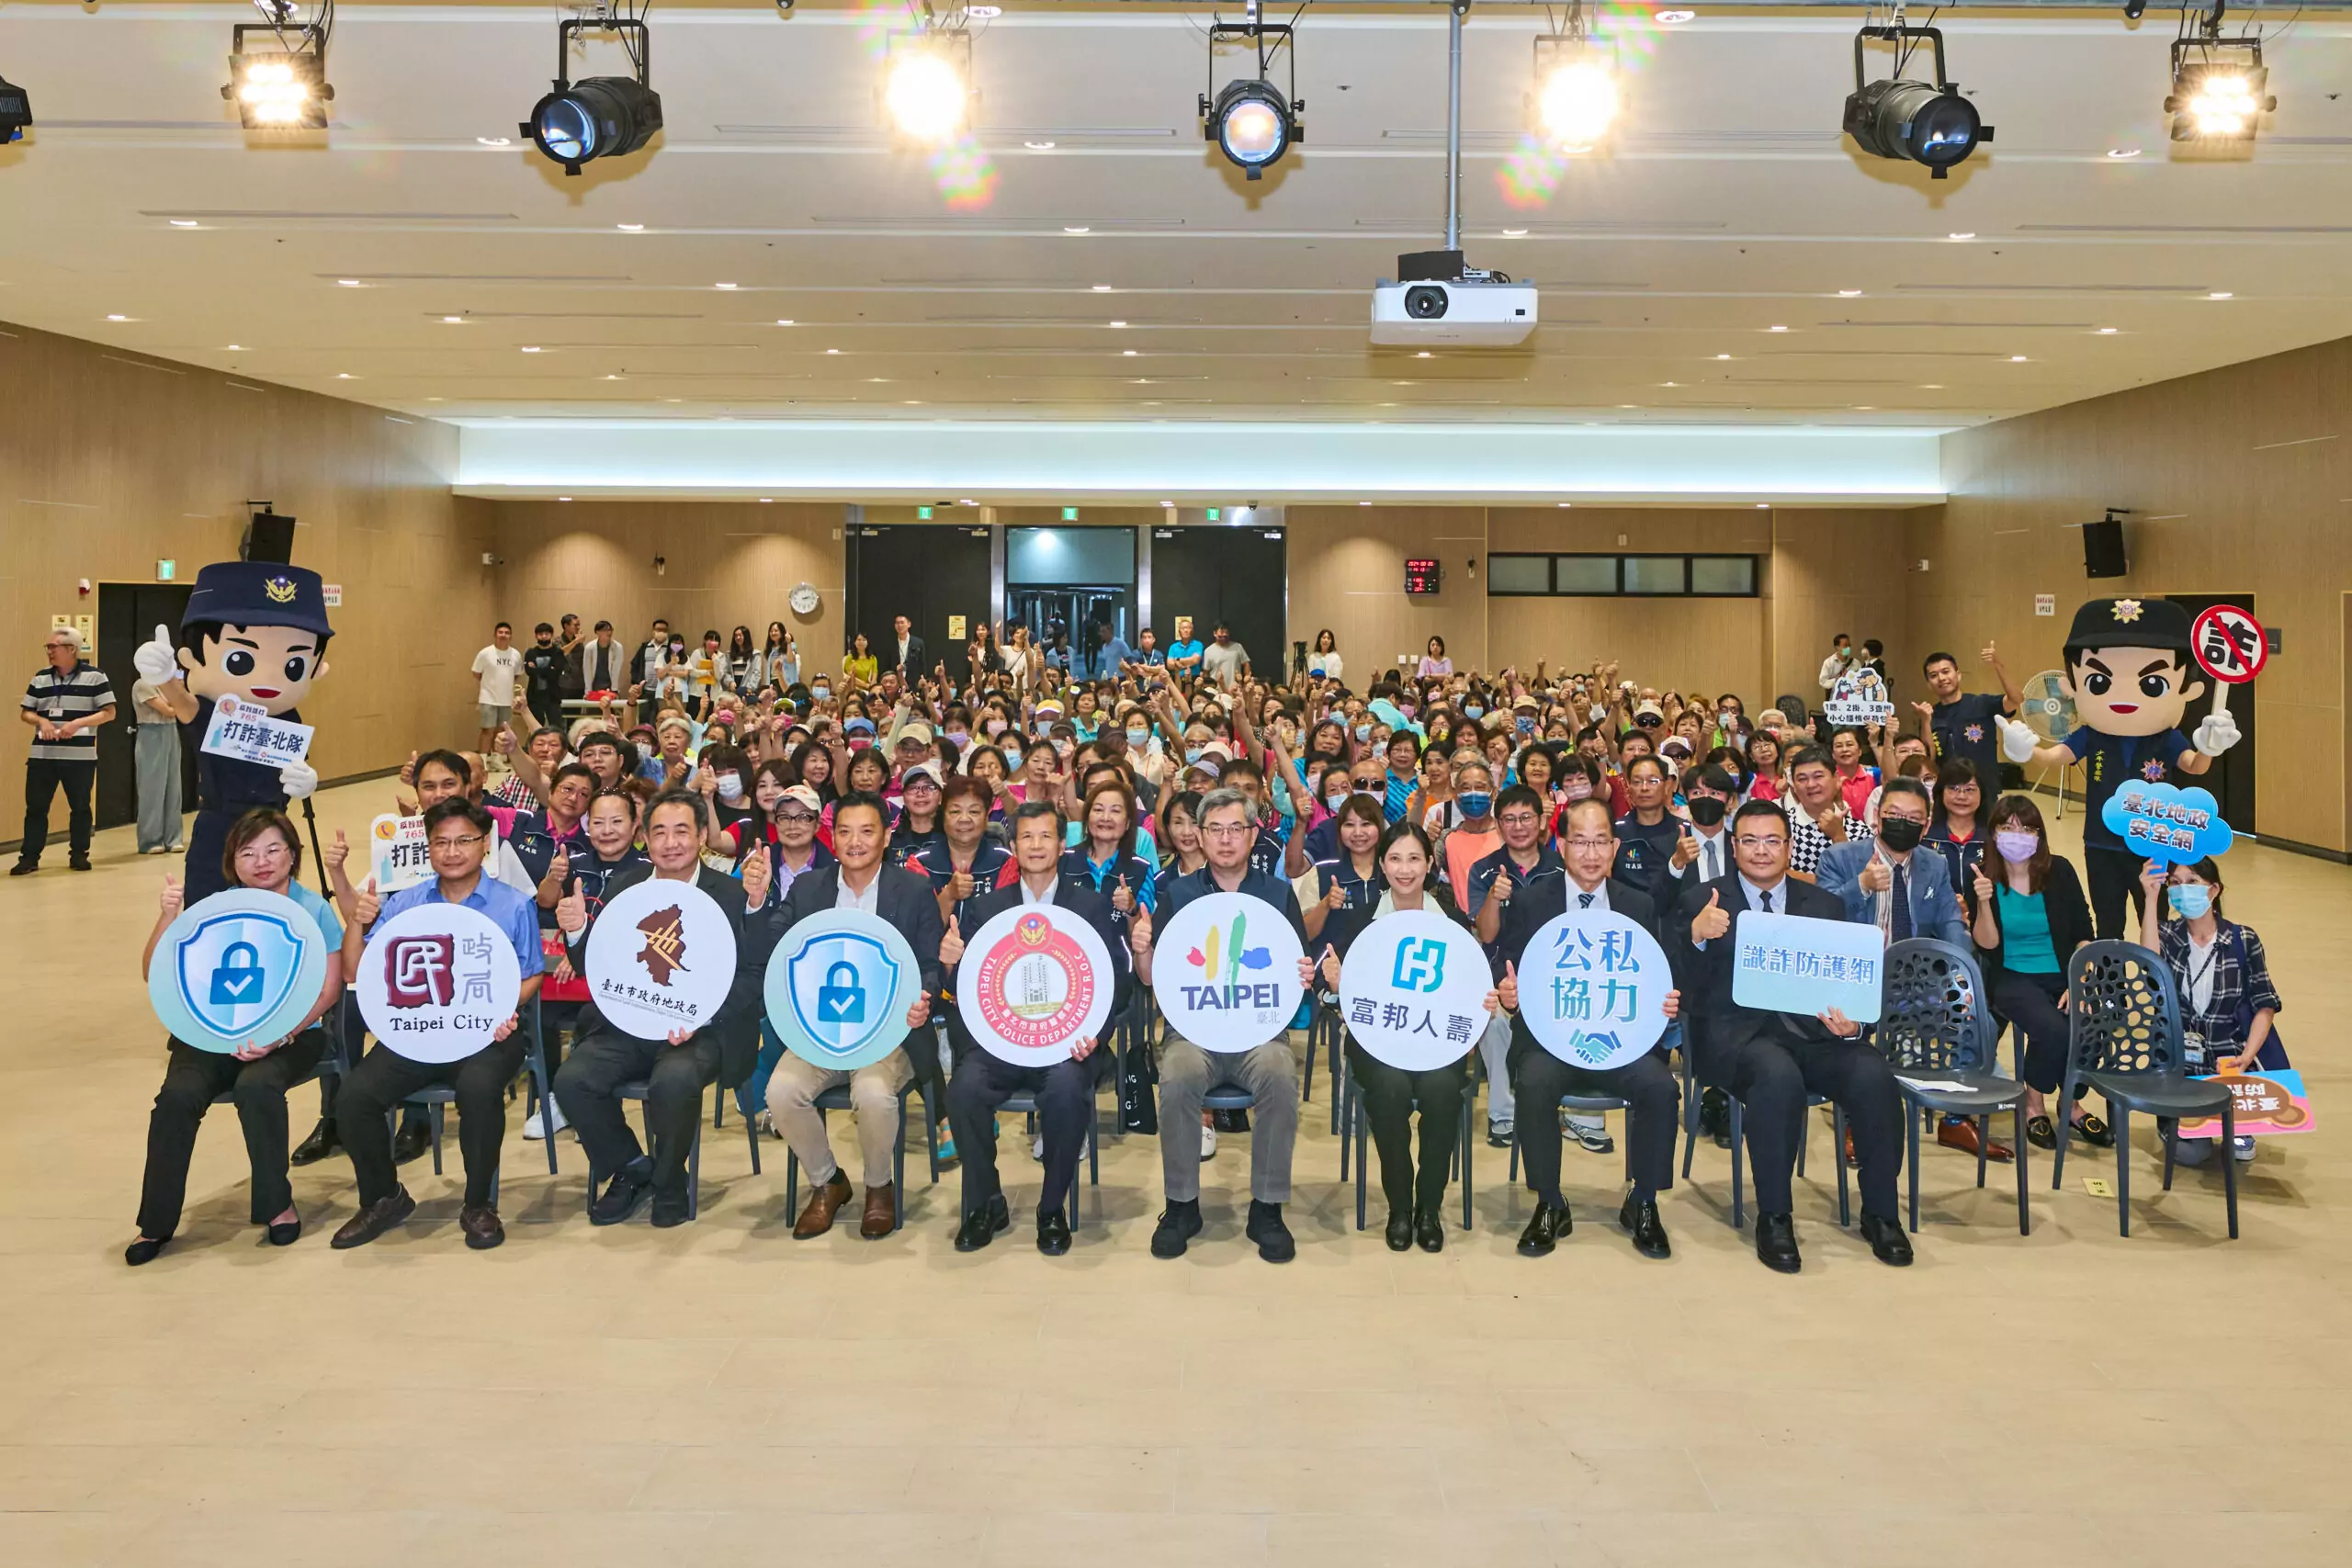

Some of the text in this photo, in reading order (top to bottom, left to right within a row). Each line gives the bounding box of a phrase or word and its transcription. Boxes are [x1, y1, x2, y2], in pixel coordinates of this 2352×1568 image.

[496, 658, 512, 666] NYC
[223, 720, 304, 753] 打詐臺北隊
[2122, 793, 2210, 830] 臺北地政
[2129, 818, 2194, 852] 安全網
[1553, 927, 1641, 974] 公私
[1742, 943, 1875, 985] 識詐防護網
[979, 956, 998, 995] TAIPEI
[601, 978, 698, 1017] 臺北市政府地政局
[981, 998, 1000, 1022] CITY
[1180, 983, 1280, 1010] TAIPEI
[1550, 976, 1639, 1023] 協力
[390, 1014, 494, 1032] Taipei City
[1039, 987, 1093, 1045] DEPARTMENT
[1256, 1010, 1281, 1025] 臺北
[1351, 997, 1474, 1044] 富邦人壽
[997, 1022, 1035, 1045] POLICE
[2233, 1097, 2281, 1111] 臺北
